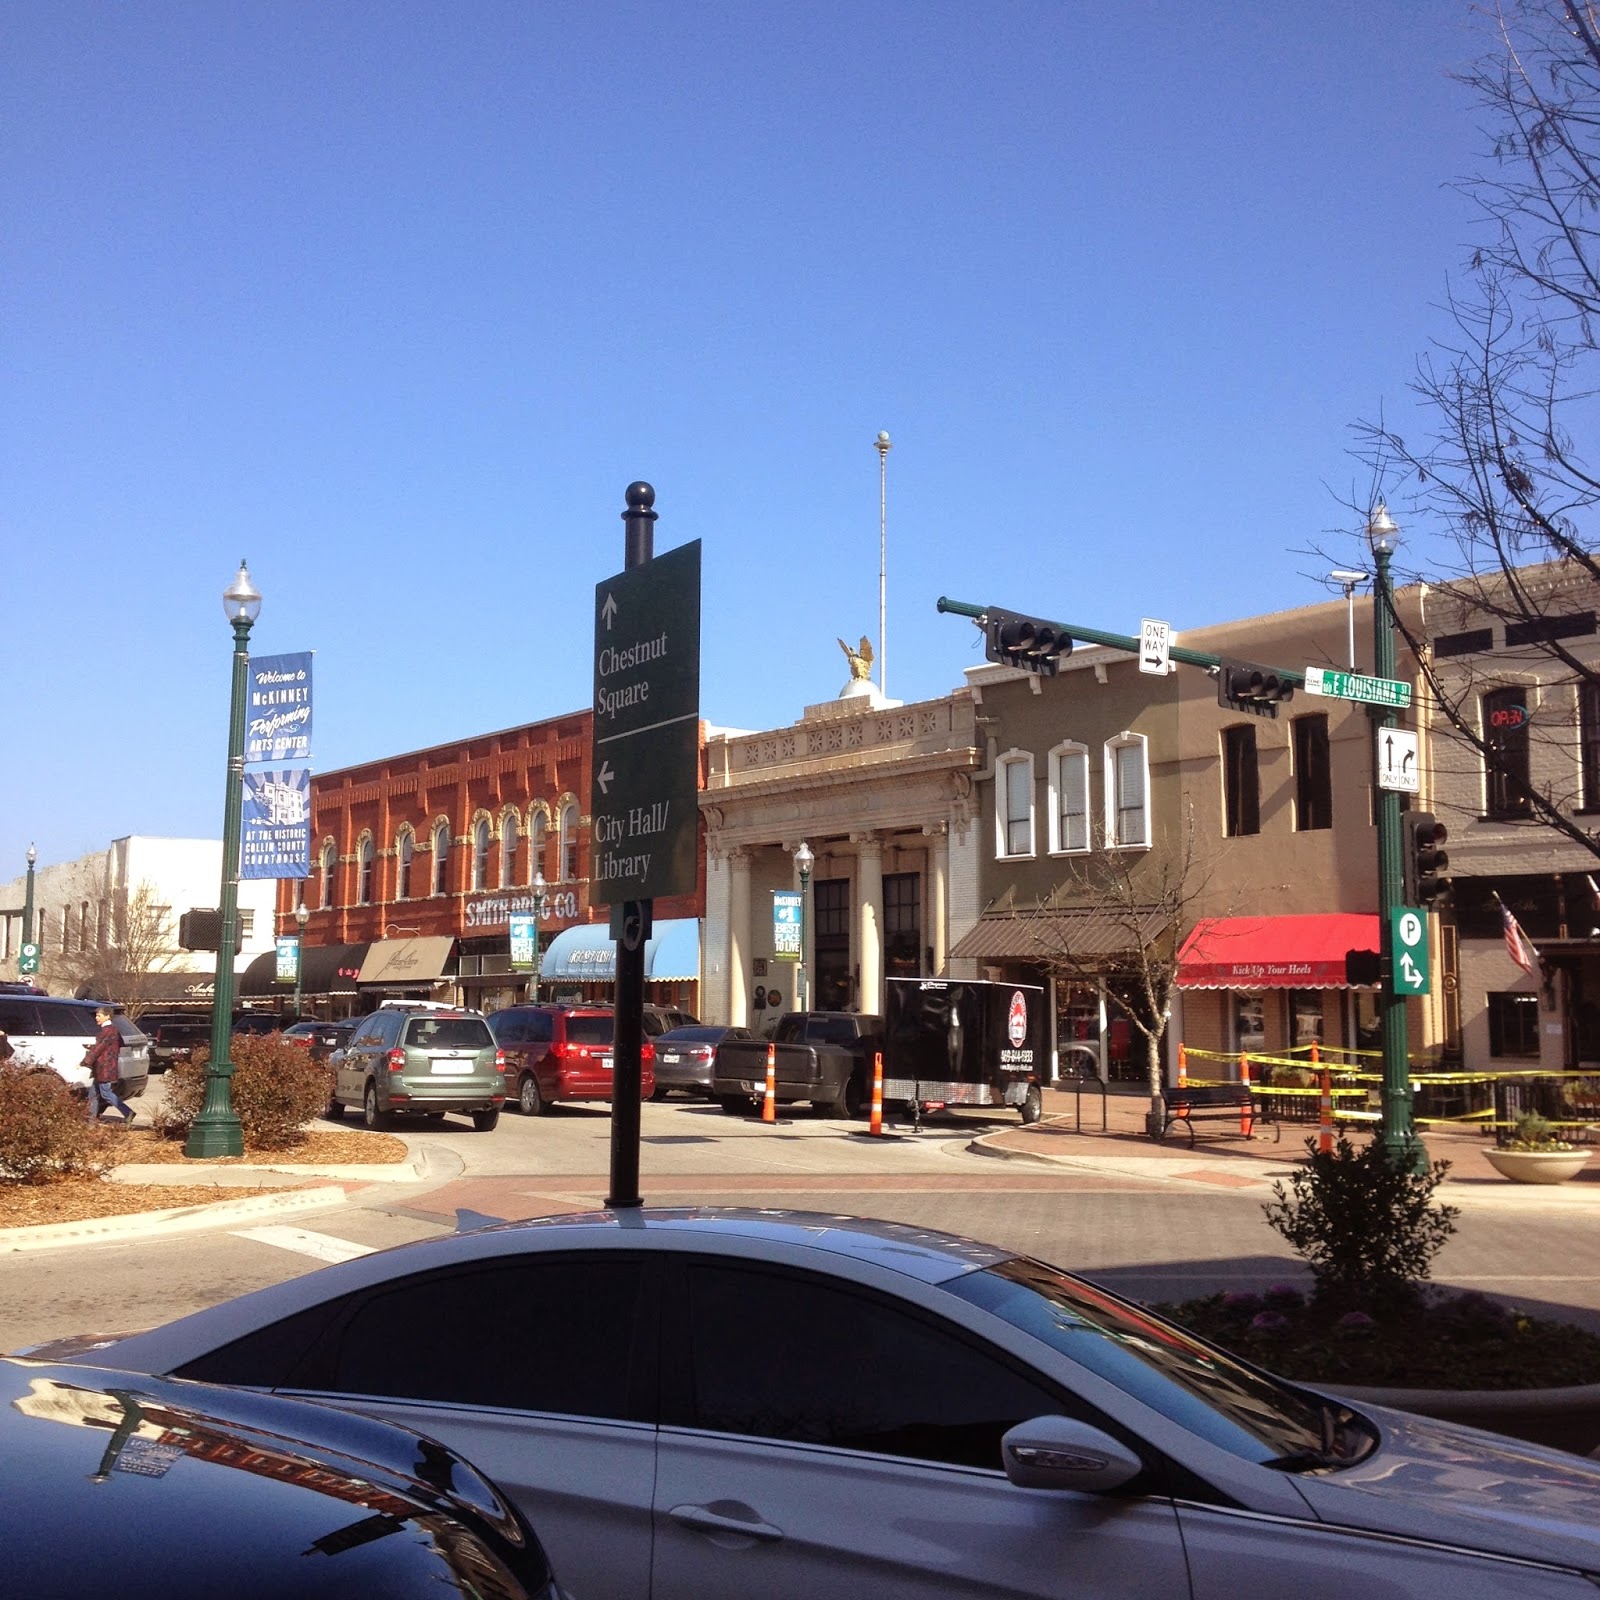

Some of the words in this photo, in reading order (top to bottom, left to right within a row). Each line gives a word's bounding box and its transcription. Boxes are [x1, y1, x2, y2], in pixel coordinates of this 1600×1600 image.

[1146, 625, 1165, 639] ONE
[599, 631, 668, 677] Chestnut
[1145, 640, 1165, 652] WAY
[255, 671, 295, 685] Welcome
[296, 669, 306, 681] to
[253, 687, 308, 706] McKINNEY
[1333, 674, 1341, 694] E
[1342, 676, 1397, 703] LOUISIANA
[1401, 686, 1409, 695] ST
[598, 681, 649, 719] Square
[249, 704, 311, 738] Performing
[1491, 709, 1522, 727] OPEN
[250, 739, 273, 752] ARTS
[274, 736, 308, 750] CENTER
[1383, 774, 1397, 783] ONLY
[1401, 775, 1415, 785] ONLY
[595, 814, 625, 848] City
[628, 800, 669, 837] Hall/
[246, 830, 256, 841] AT
[259, 830, 272, 840] THE
[274, 828, 306, 840] HISTORIC
[245, 842, 275, 853] COLLIN
[277, 840, 306, 852] COUNTY
[245, 852, 306, 865] COURTHOUSE
[594, 851, 651, 883] Library
[465, 898, 509, 927] SMITH
[554, 891, 579, 919] CO.
[778, 906, 795, 922] #1
[774, 922, 800, 934] BEST
[1407, 920, 1416, 939] P
[774, 933, 800, 942] PLACE
[774, 941, 784, 952] TO
[785, 941, 800, 952] LIVE
[1232, 964, 1250, 975] Kick
[1252, 965, 1265, 978] Up
[1267, 964, 1286, 974] Your
[1288, 963, 1311, 974] Heels
